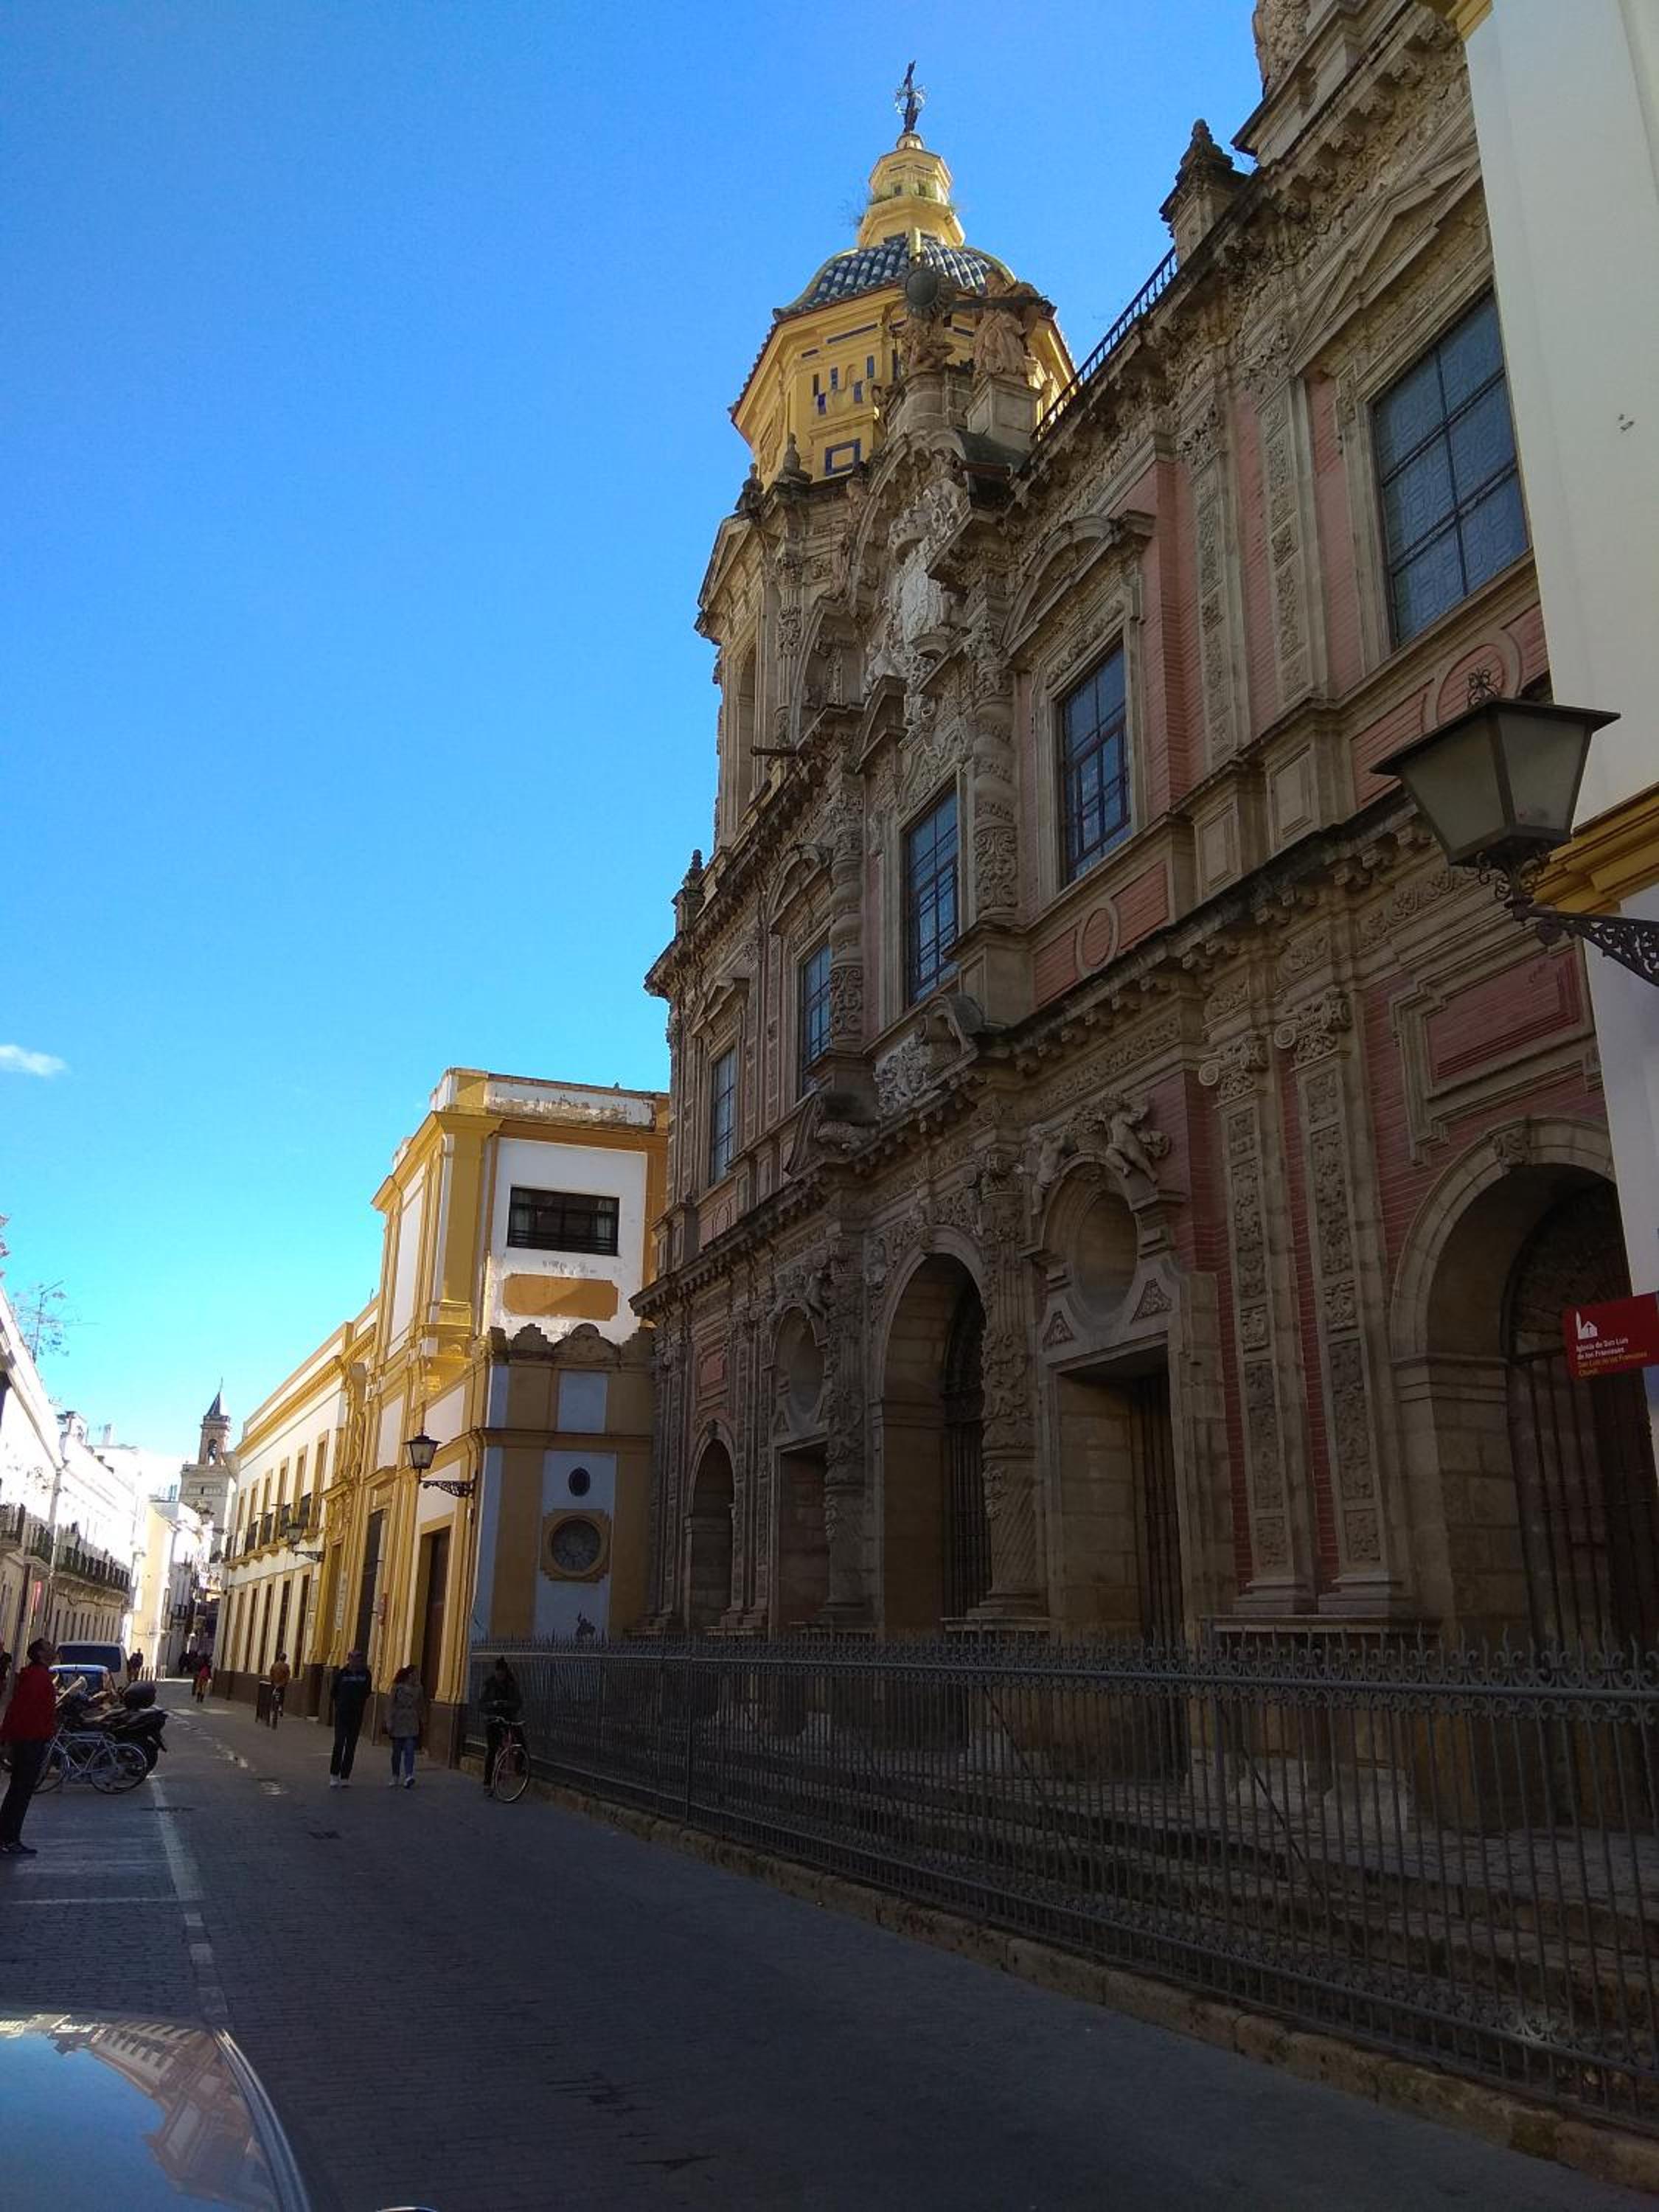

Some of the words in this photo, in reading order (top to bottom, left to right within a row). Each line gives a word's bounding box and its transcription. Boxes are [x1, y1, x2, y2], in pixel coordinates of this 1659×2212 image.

[1603, 1339, 1615, 1347] San
[1615, 1338, 1629, 1346] Luis
[1577, 1352, 1585, 1360] de
[1585, 1351, 1594, 1359] los
